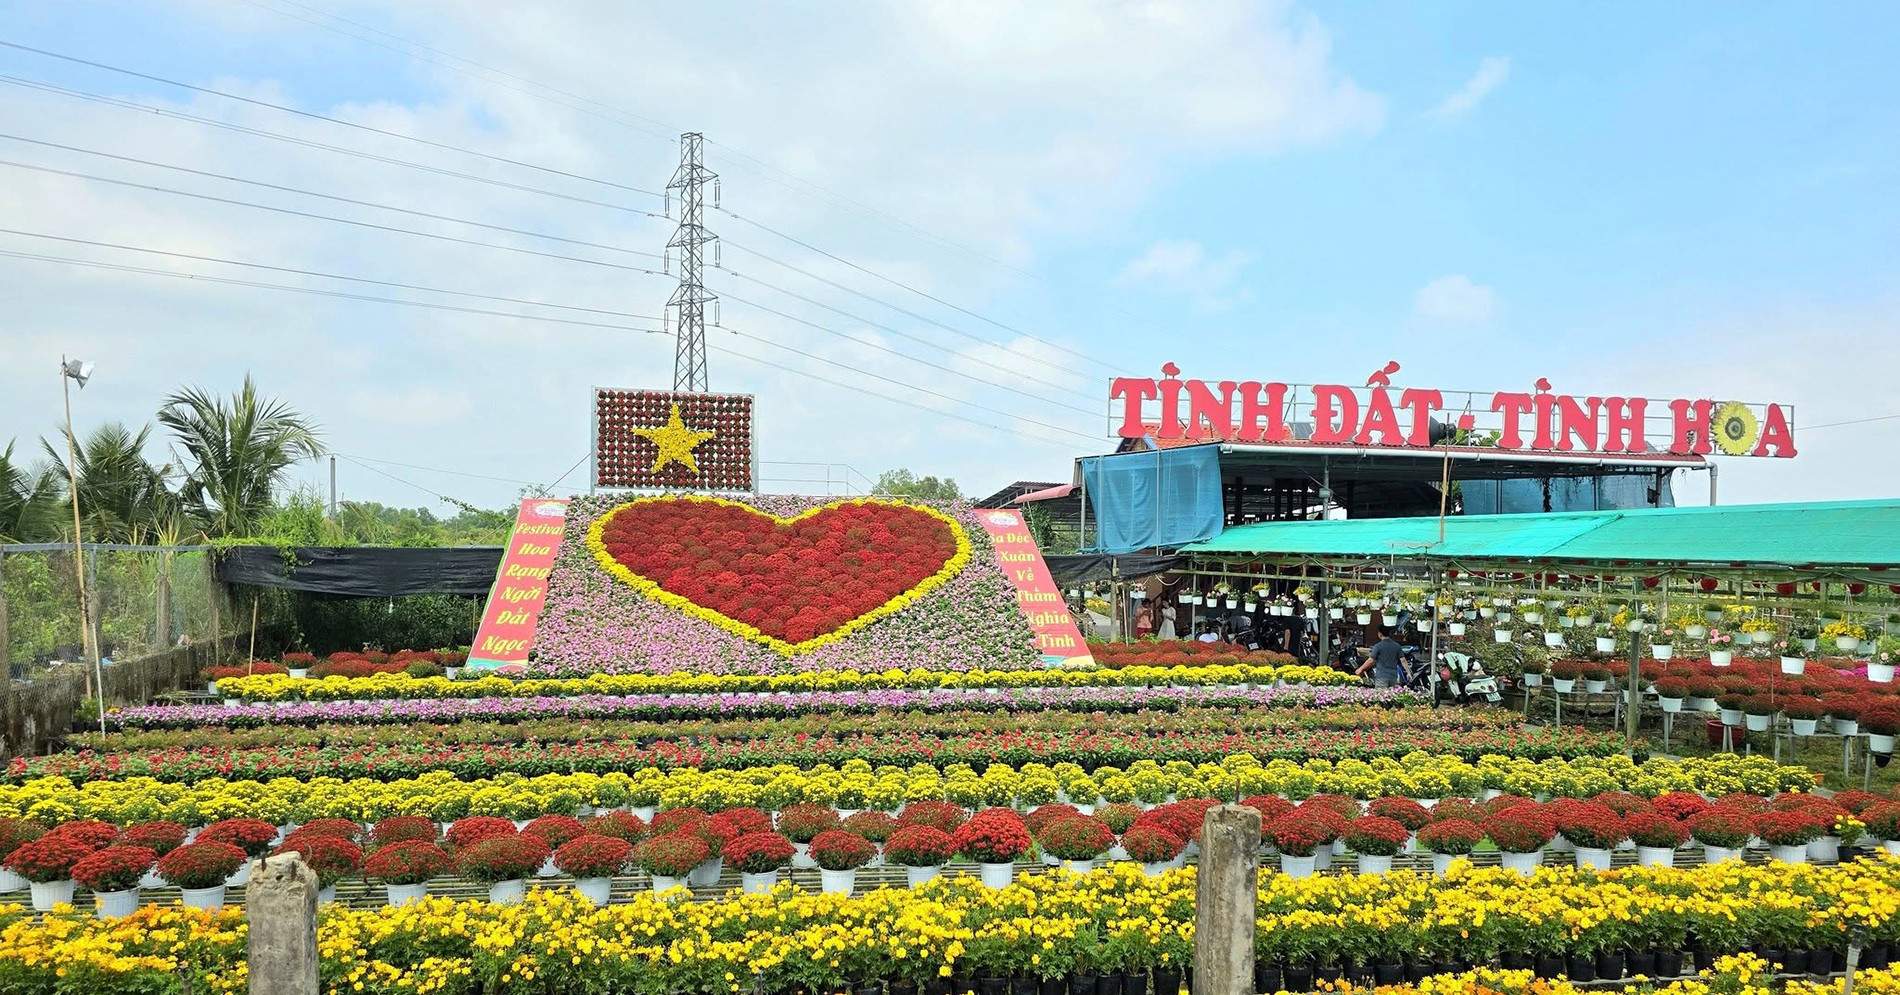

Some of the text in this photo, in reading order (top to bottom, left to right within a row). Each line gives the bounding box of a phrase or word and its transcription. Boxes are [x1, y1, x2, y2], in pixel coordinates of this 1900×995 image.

[1310, 360, 1444, 446] ĐẤT
[515, 522, 565, 535] Festival
[518, 543, 551, 555] Hoa
[1000, 550, 1036, 562] Xuân
[505, 563, 550, 580] Rạng
[1016, 567, 1034, 581] Về
[500, 586, 542, 604] Ngời
[496, 607, 531, 624] Đất
[481, 635, 528, 655] Ngọc
